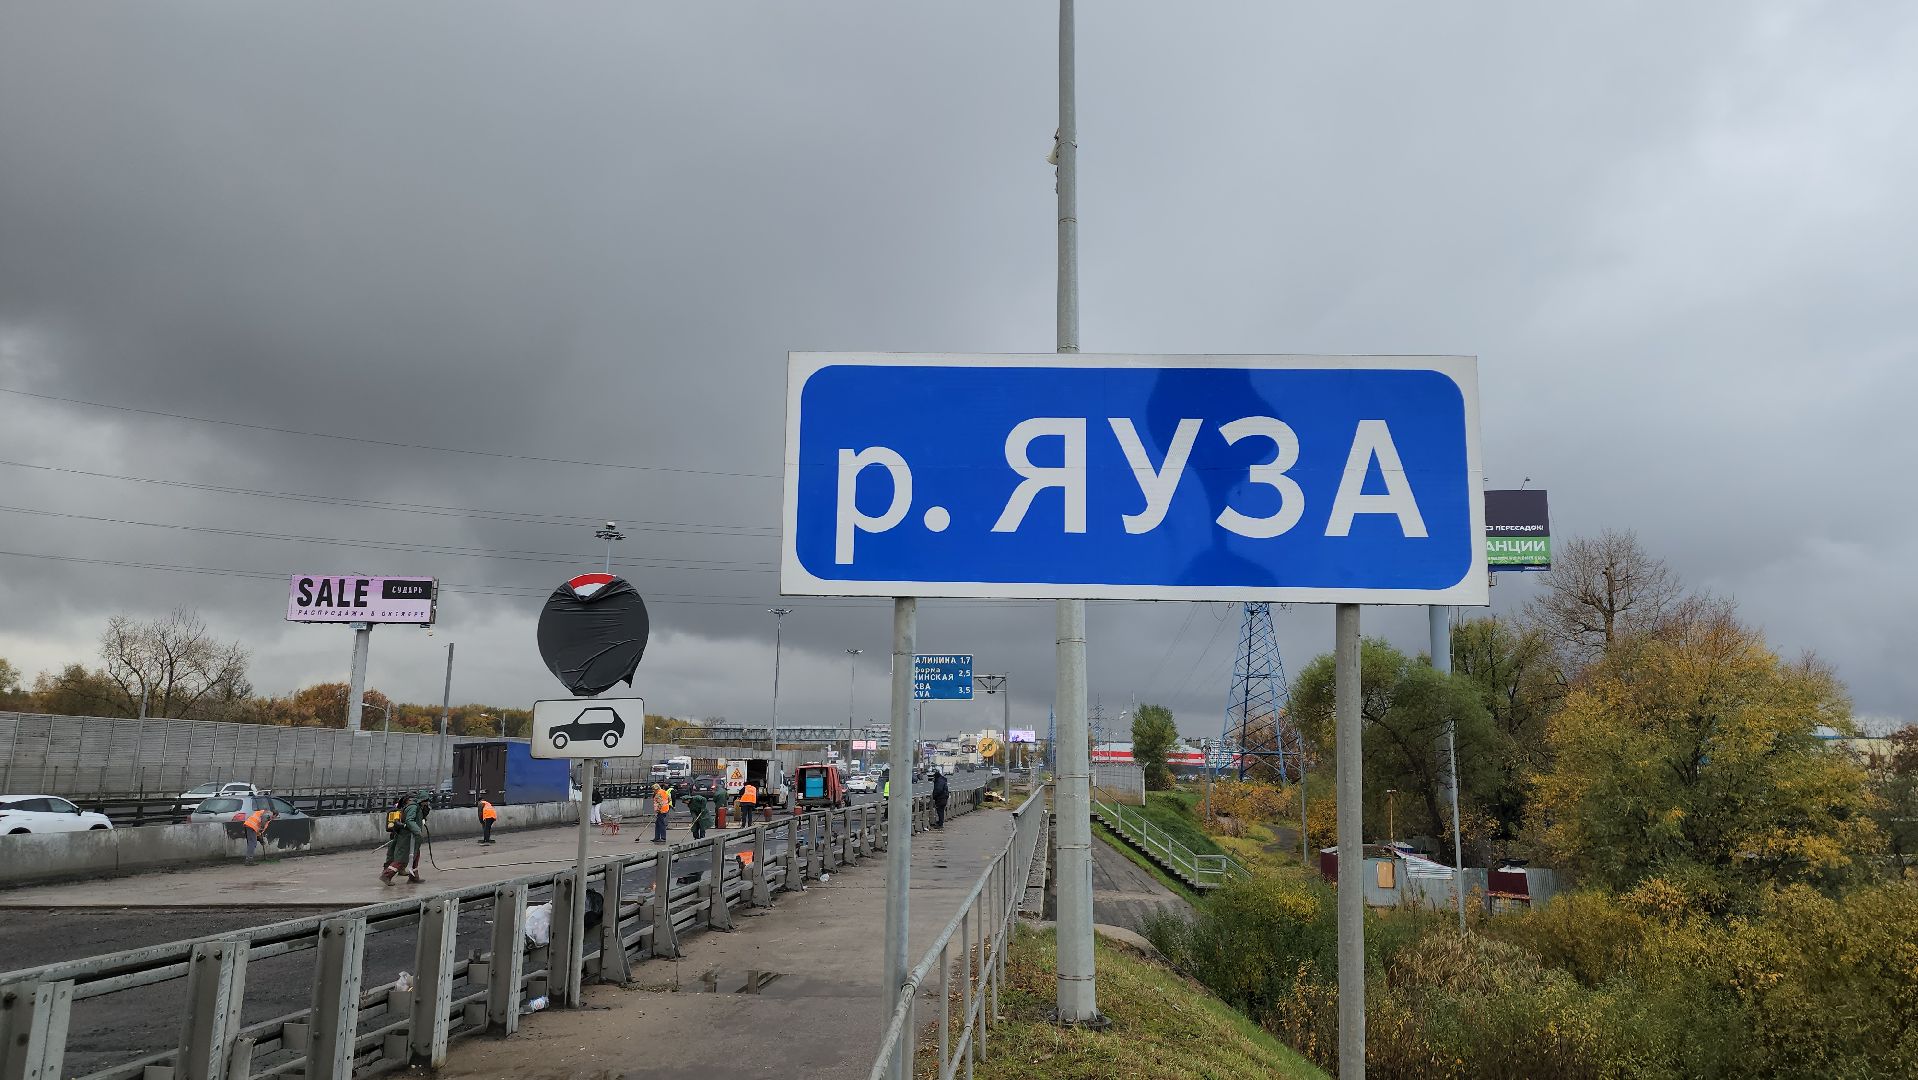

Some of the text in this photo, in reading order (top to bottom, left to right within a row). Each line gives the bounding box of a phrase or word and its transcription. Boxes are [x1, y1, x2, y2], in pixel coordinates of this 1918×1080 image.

[834, 415, 1430, 565] р. ЯУЗА
[1486, 540, 1546, 553] АНЦИИ
[296, 577, 370, 608] SALE
[391, 585, 423, 594] СУДАРЬ
[915, 656, 957, 664] АЛИНИНА
